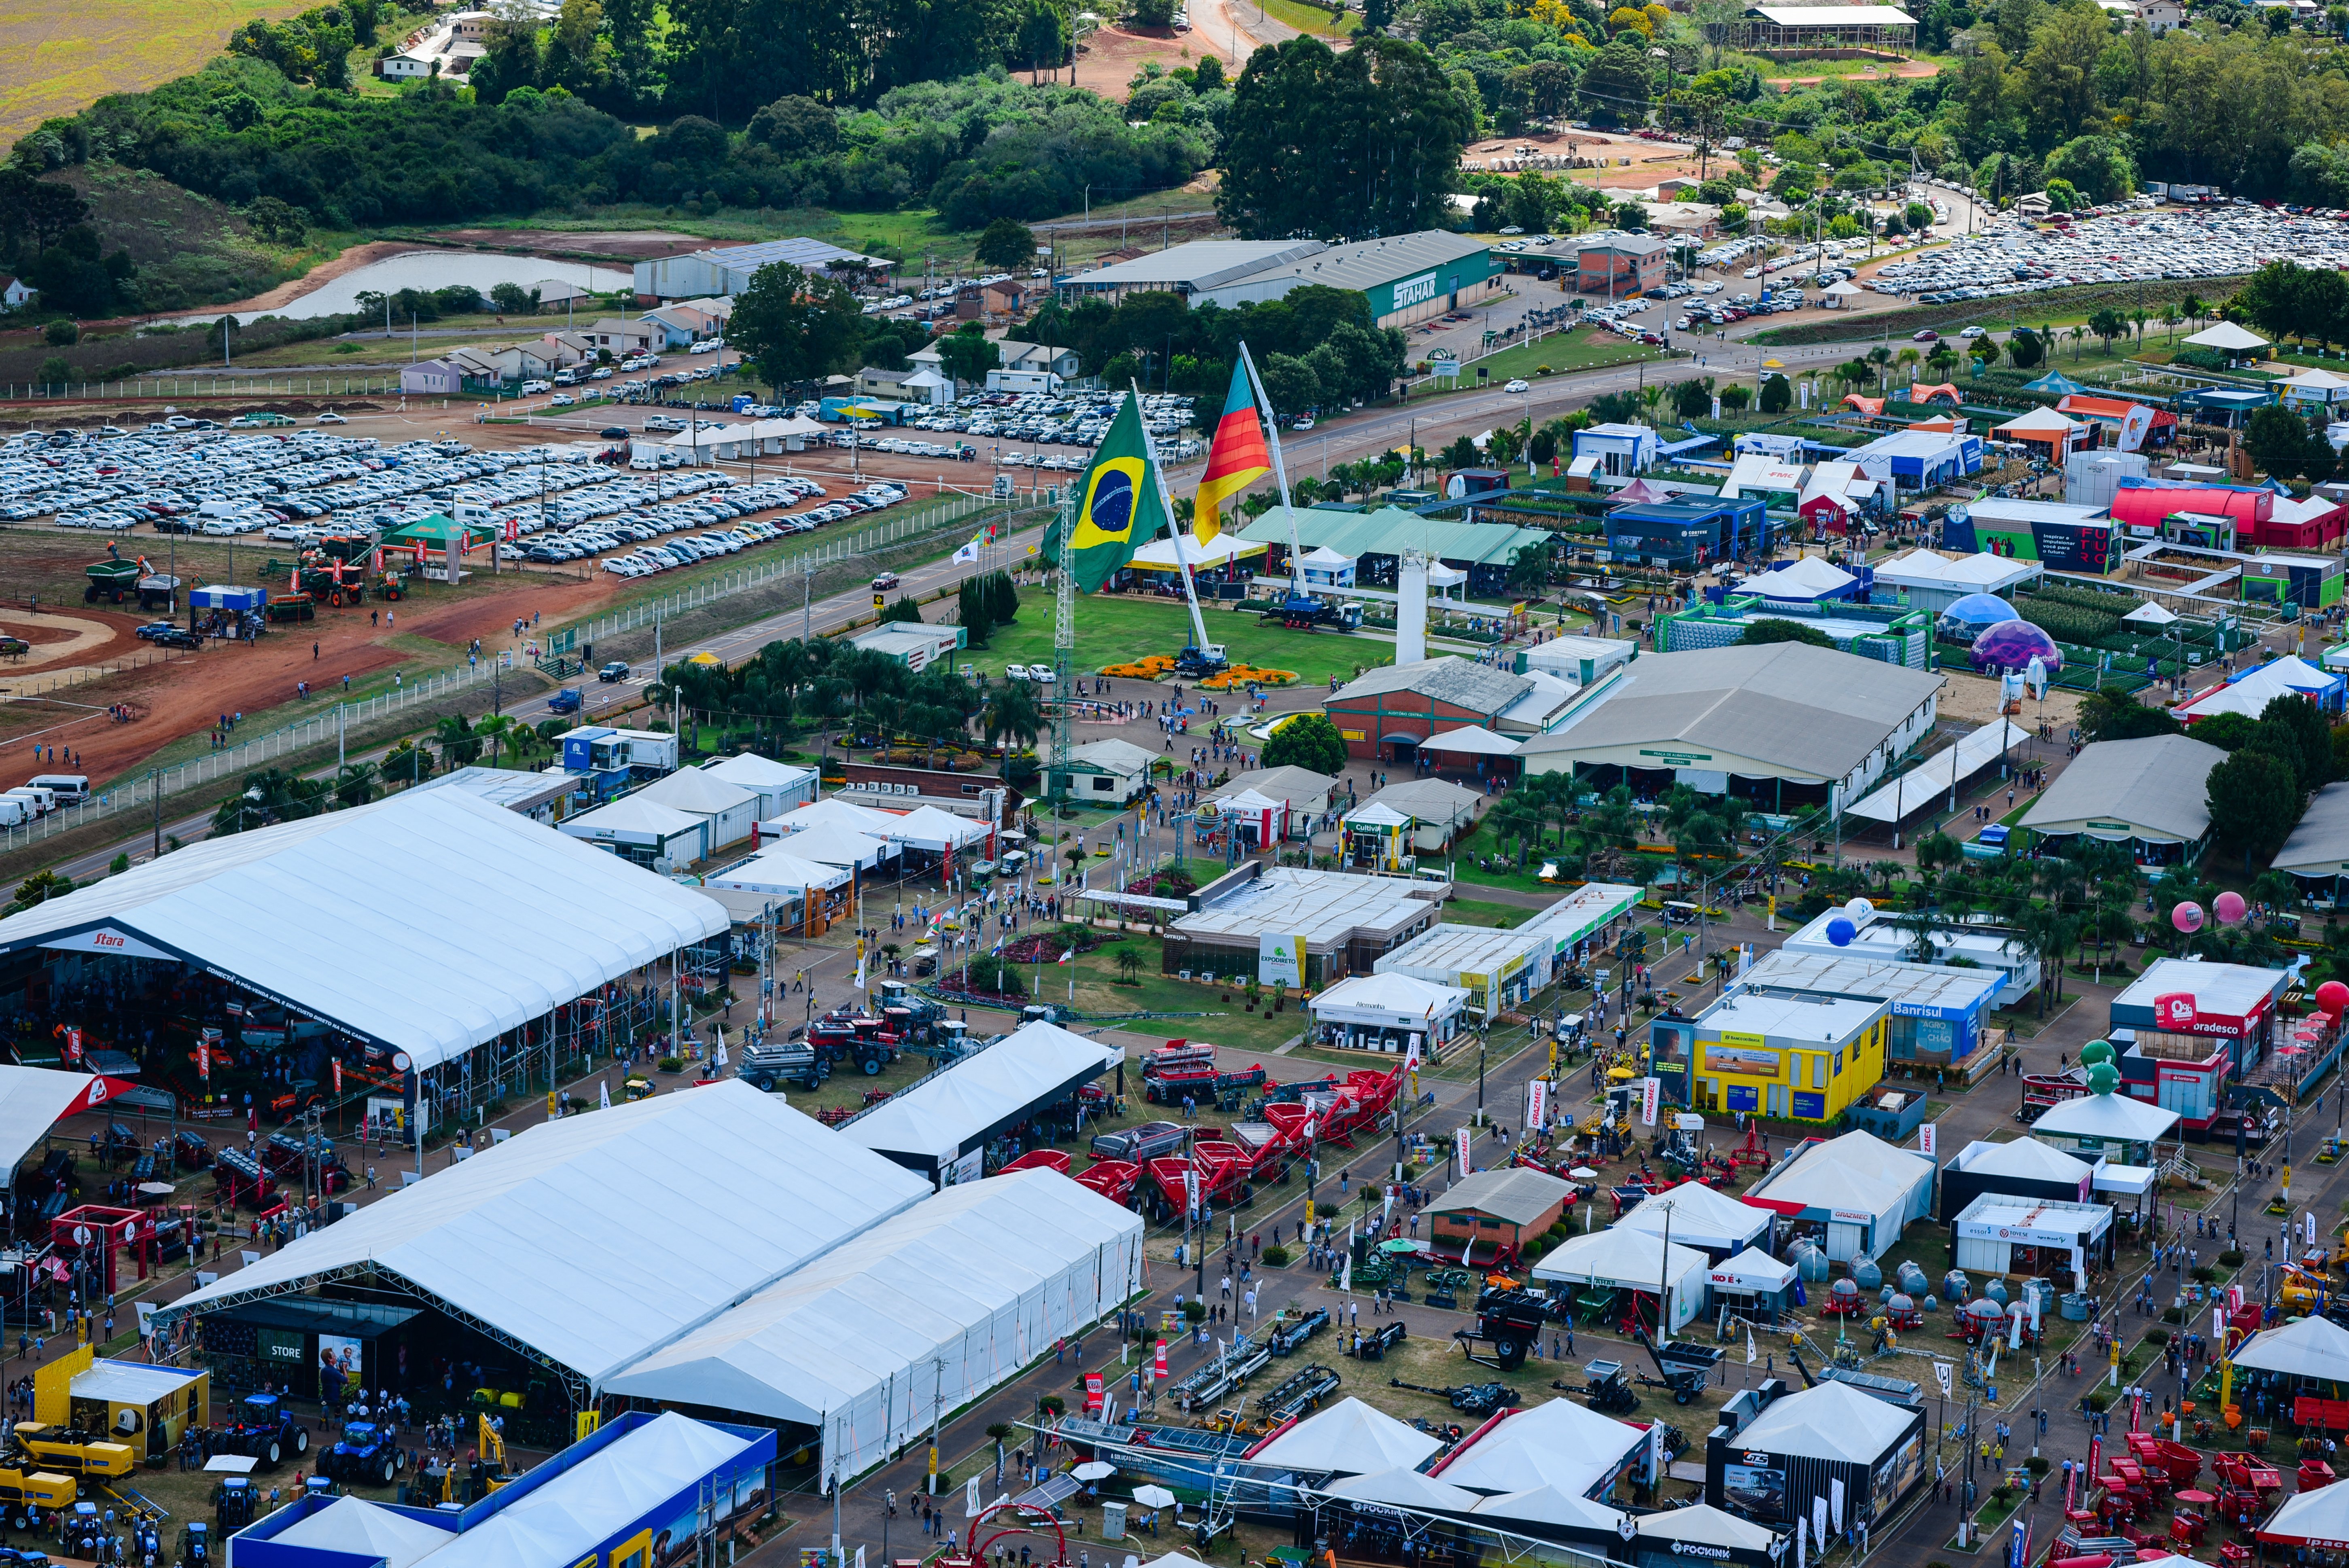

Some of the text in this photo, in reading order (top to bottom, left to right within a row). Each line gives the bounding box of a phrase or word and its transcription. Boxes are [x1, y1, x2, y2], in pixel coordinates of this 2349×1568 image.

[1393, 271, 1436, 309] STAHAR
[94, 933, 124, 947] Stara
[1261, 955, 1296, 965] EXPODIRETO
[206, 966, 234, 983] CONECTA
[285, 1002, 297, 1011] SEM
[296, 1007, 313, 1017] CUSTO
[351, 1032, 371, 1043] CABINE
[1356, 1001, 1385, 1009] Alemanha
[1894, 1003, 1942, 1017] Banrisul
[1923, 1021, 1946, 1030] AGRO
[2194, 1023, 2239, 1034] bradesco
[1928, 1033, 1950, 1043] CHÃO
[1532, 1084, 1542, 1126] GRAZMEC
[1645, 1081, 1656, 1122] GRAZMEC
[1464, 1132, 1472, 1175] GRAZMEC
[1835, 1211, 1868, 1220] GRAZMEC
[1728, 1273, 1734, 1284] É
[272, 1346, 301, 1358] STORE
[931, 1453, 936, 1461] C
[1605, 1461, 1622, 1485] BALDAN
[1683, 1544, 1730, 1559] FOCKINK
